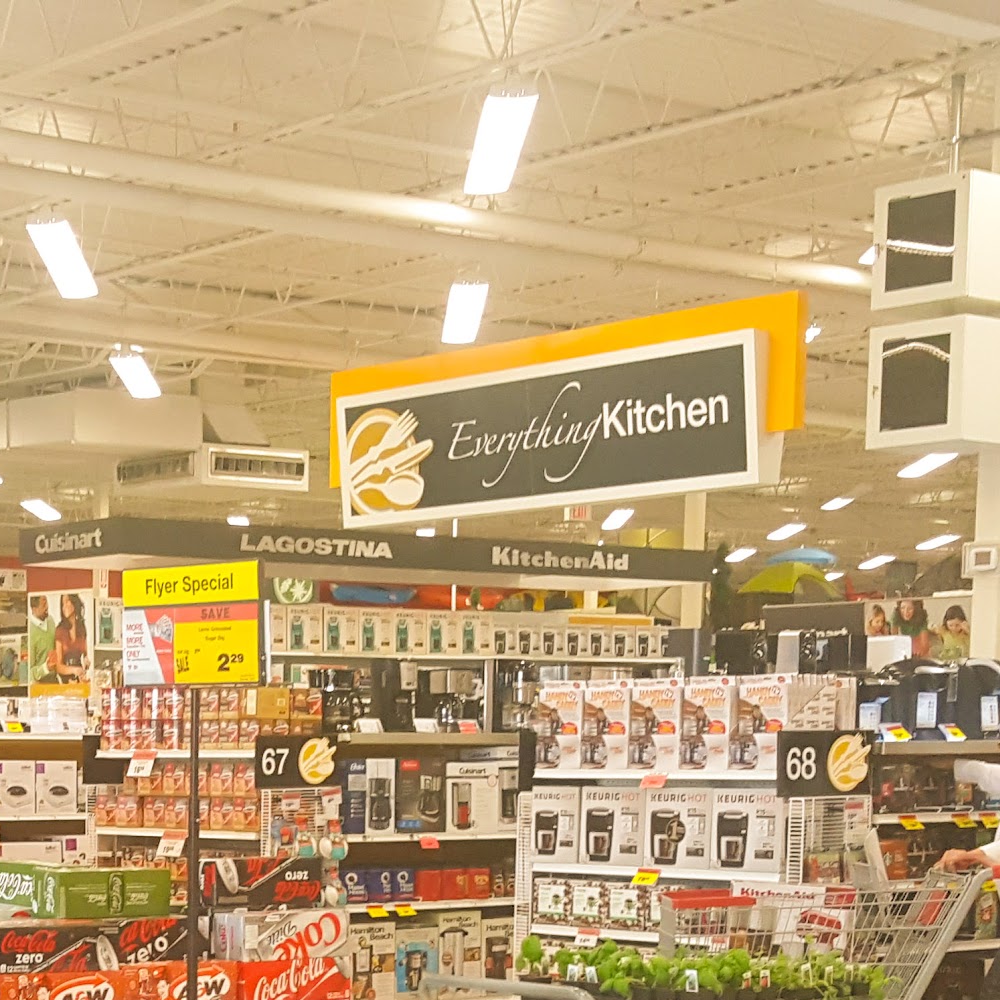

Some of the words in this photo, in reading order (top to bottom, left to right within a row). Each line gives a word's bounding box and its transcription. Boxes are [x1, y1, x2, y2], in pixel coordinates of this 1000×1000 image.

[448, 381, 602, 488] Everything
[601, 393, 729, 439] Kitchen
[35, 530, 101, 554] Cuisinart
[239, 533, 392, 560] LAGOSTINA
[491, 546, 629, 572] KitchenAid
[145, 578, 178, 598] Flyer
[182, 573, 234, 595] Special
[200, 606, 230, 620] SAVE
[261, 749, 289, 775] 67
[459, 767, 486, 775] Cuisinart
[786, 747, 816, 780] 68
[586, 792, 619, 801] KEURIG
[650, 793, 686, 802] KEURIG
[717, 794, 755, 803] KEURIG
[284, 870, 309, 881] zero
[1, 929, 58, 954] Coca-Cola
[273, 912, 341, 961] Coke
[350, 926, 385, 935] Hamilton
[15, 952, 44, 964] zero
